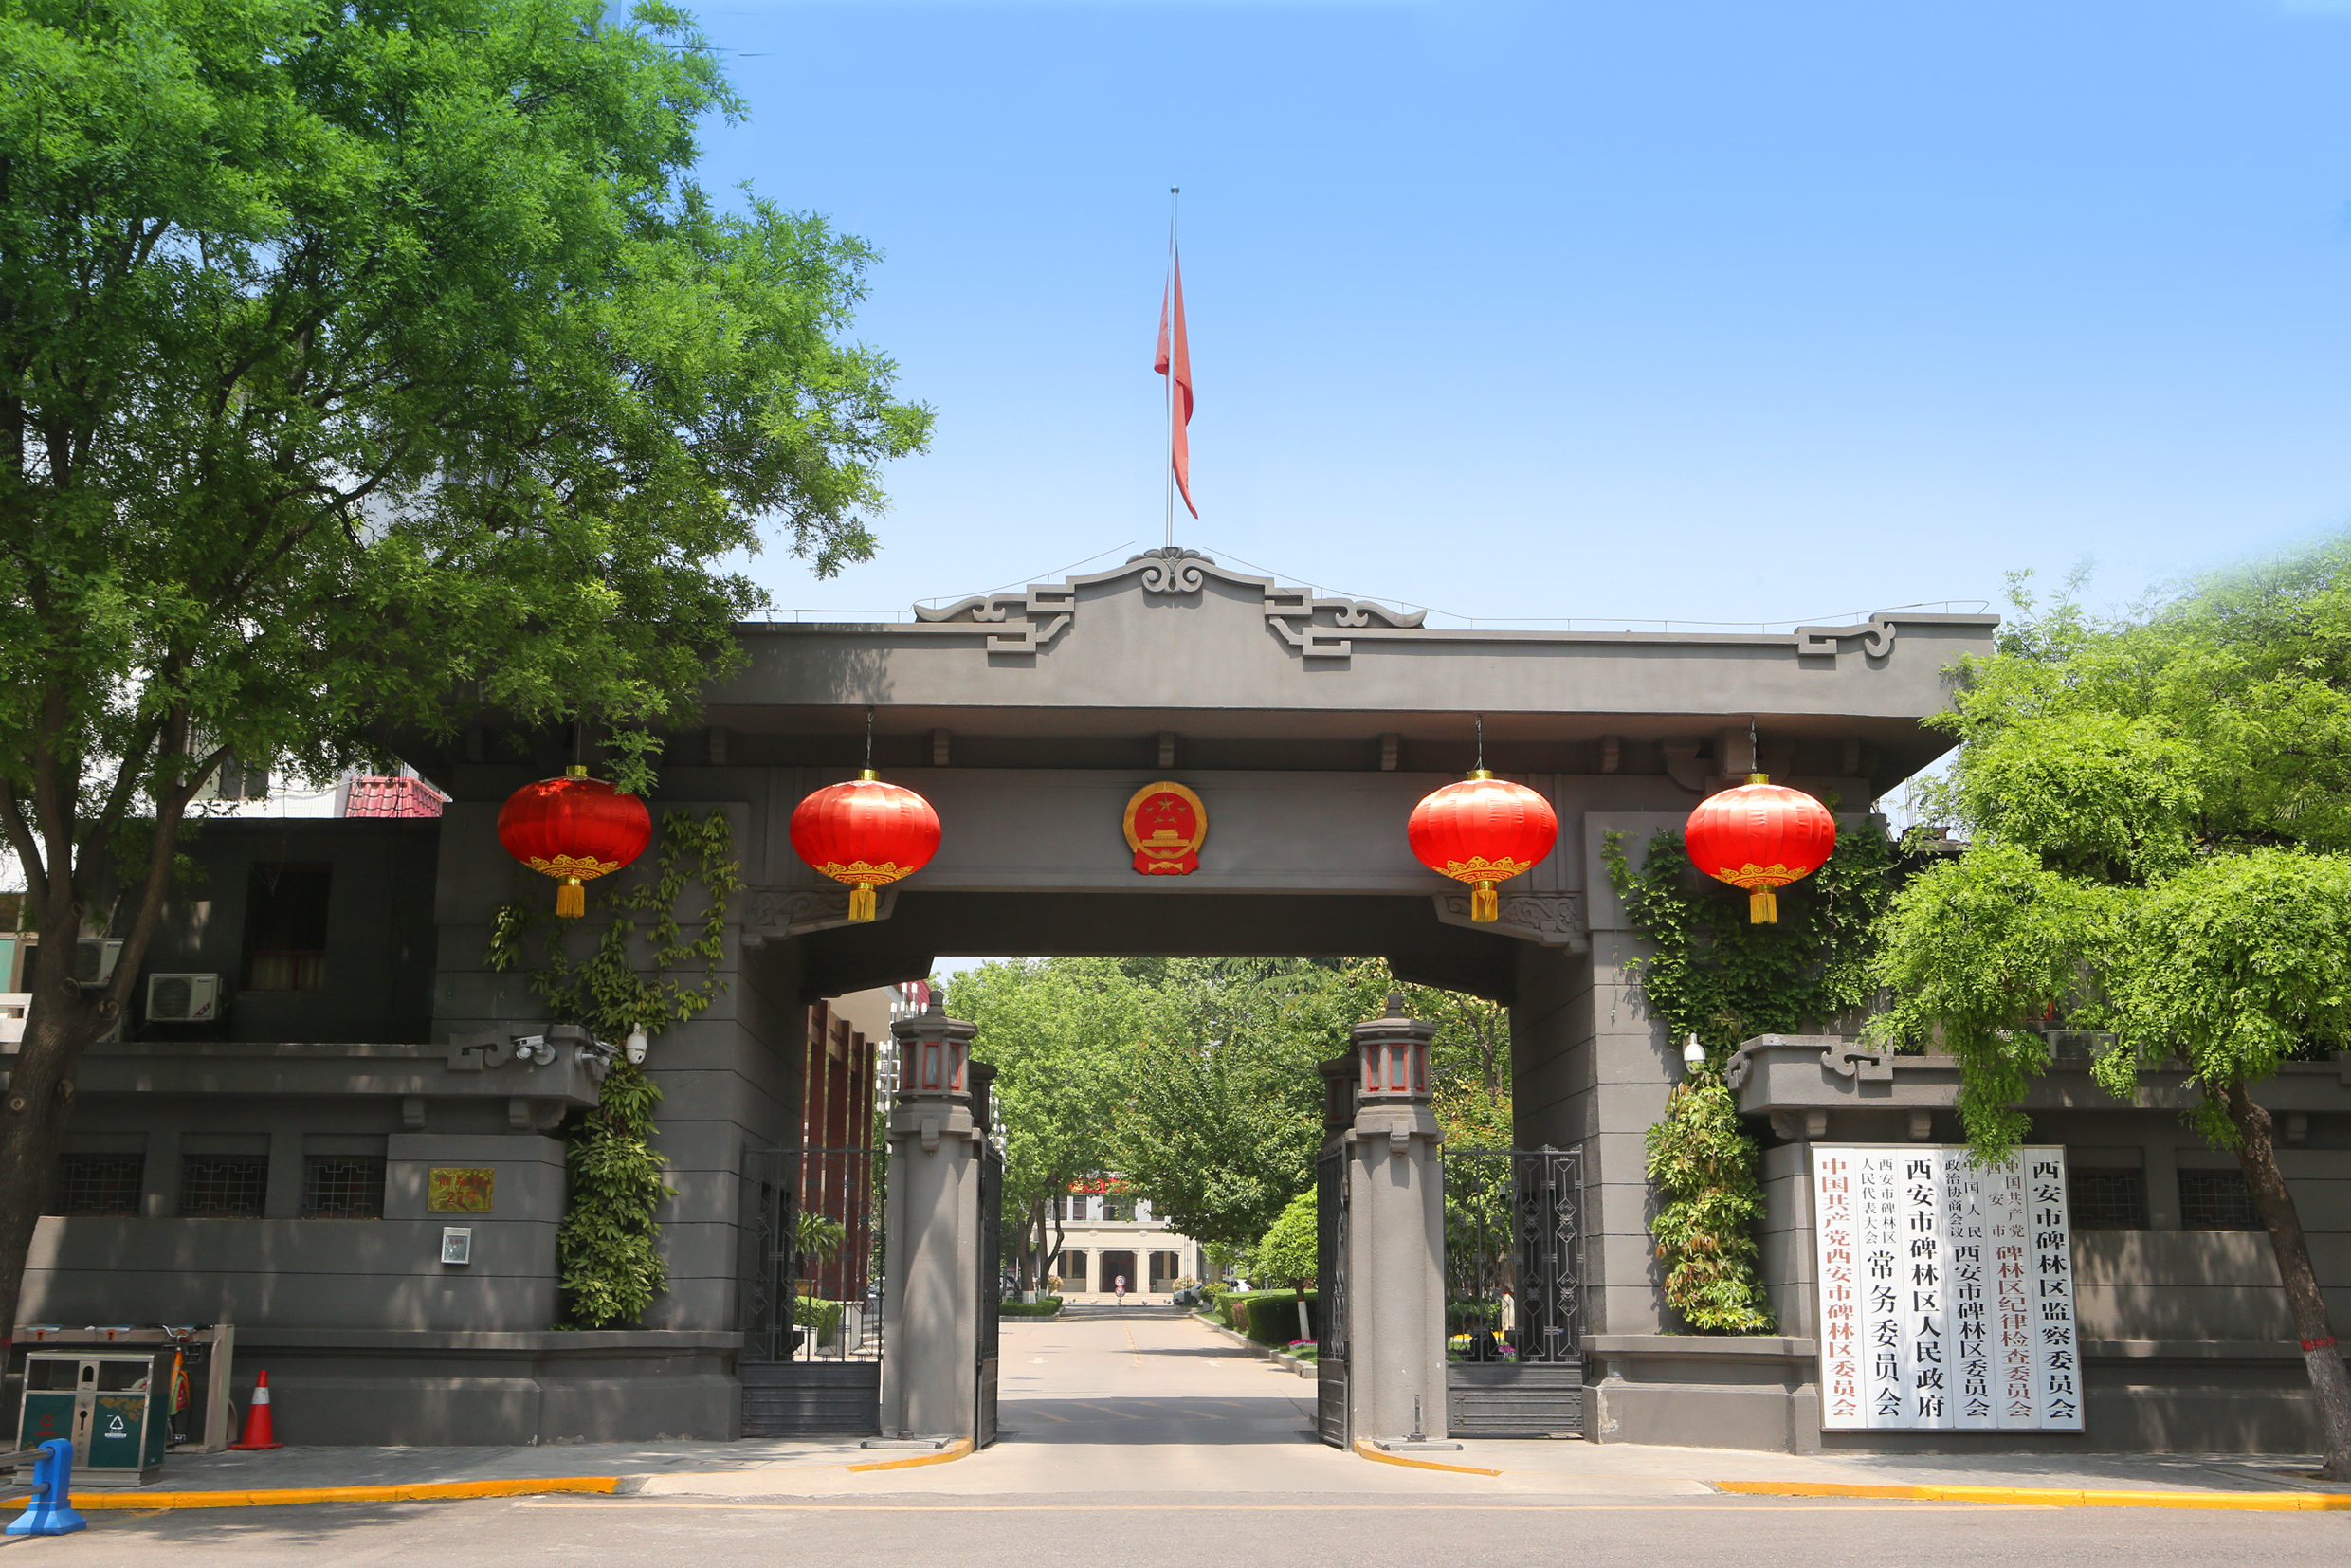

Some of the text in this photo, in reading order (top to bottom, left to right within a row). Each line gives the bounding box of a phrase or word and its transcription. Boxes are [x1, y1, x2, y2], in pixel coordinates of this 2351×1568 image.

[1861, 1158, 1878, 1245] 人民代表大会
[1879, 1158, 1896, 1244] 西安市碑林区
[1945, 1159, 1964, 1239] 政治协商会议
[2005, 1159, 2025, 1238] 中国共产党
[1822, 1158, 1857, 1417] 中国共产党西安市碑林区委员会
[1868, 1250, 1902, 1417] 常务委员会
[1904, 1158, 1945, 1418] 西安市碑林区人民政府
[1954, 1245, 1990, 1417] 西安市碑林区委员会
[1995, 1245, 2032, 1417] 碑林区纪律检查委员会
[2032, 1160, 2076, 1419] 西安市碑林区监察委员会
